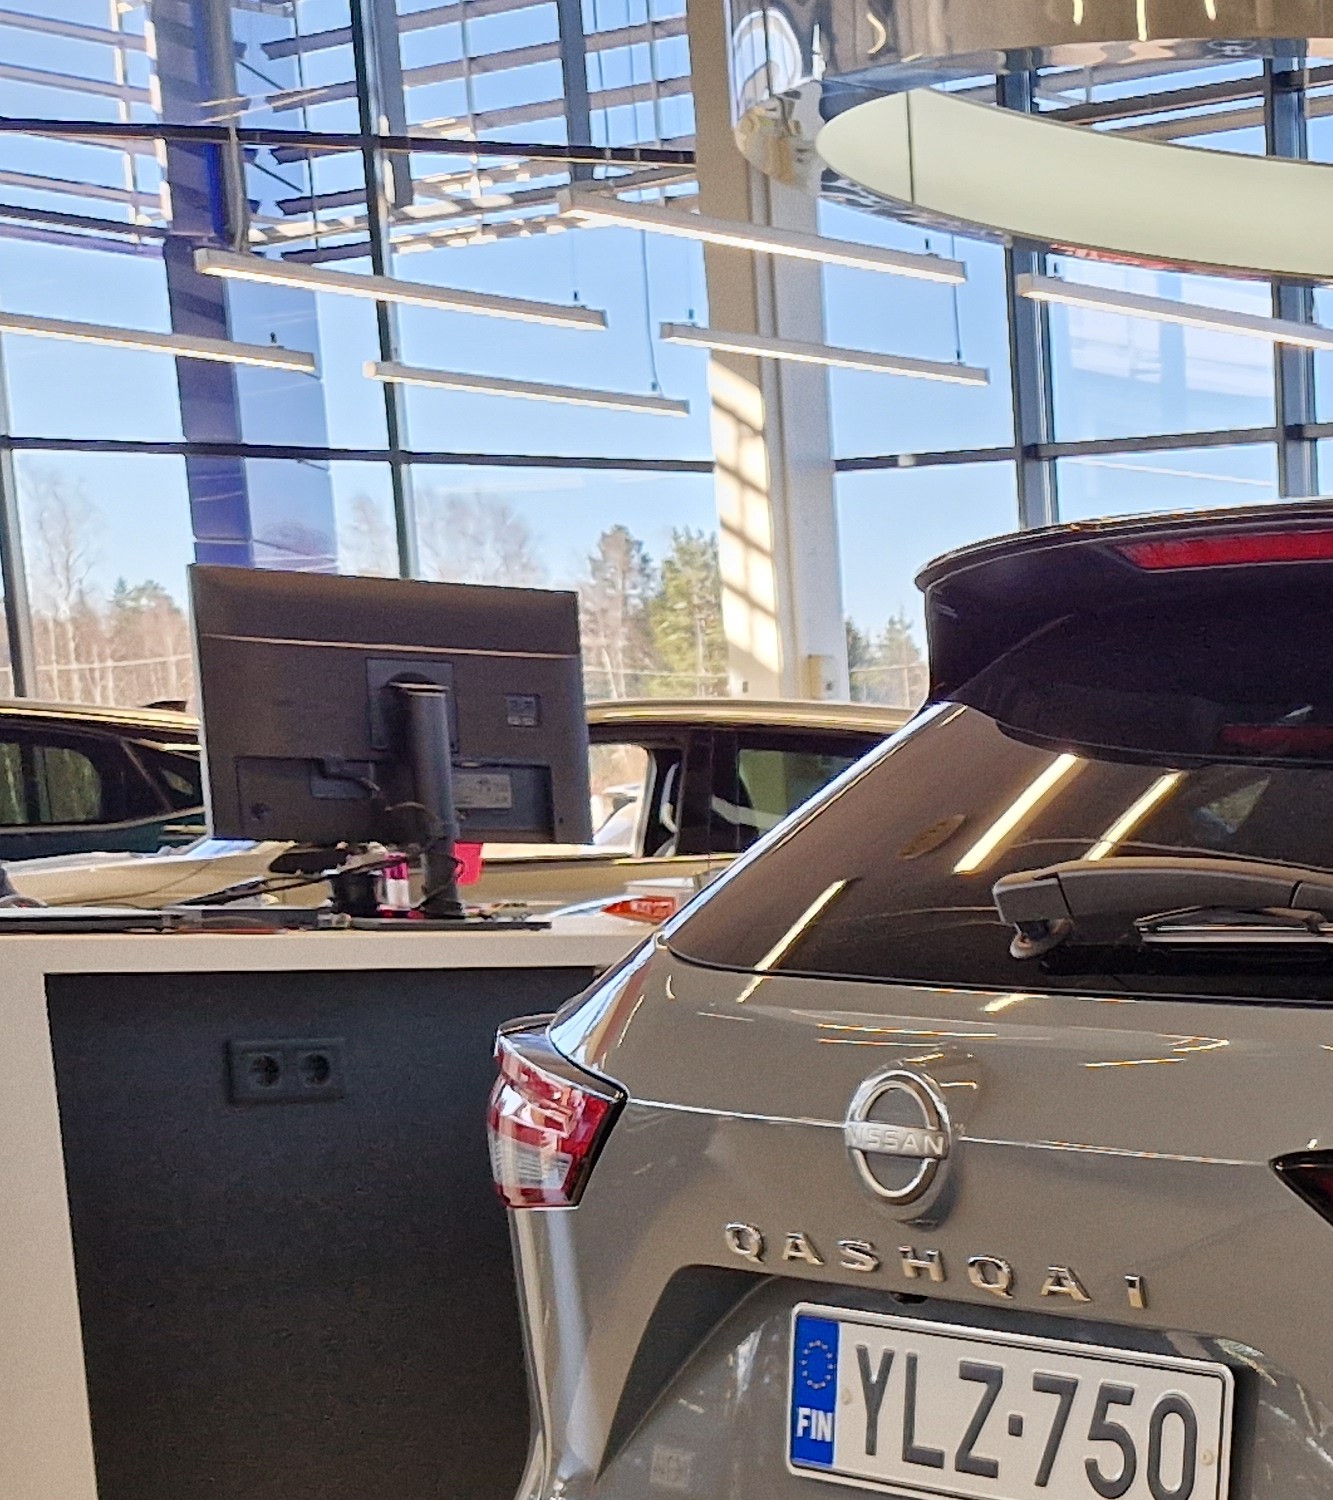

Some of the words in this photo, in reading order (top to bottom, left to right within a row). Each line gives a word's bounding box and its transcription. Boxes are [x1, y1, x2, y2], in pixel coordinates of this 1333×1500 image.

[847, 1124, 945, 1157] NISSAN
[724, 1221, 1148, 1310] QASHQAI
[797, 1406, 834, 1442] FIN
